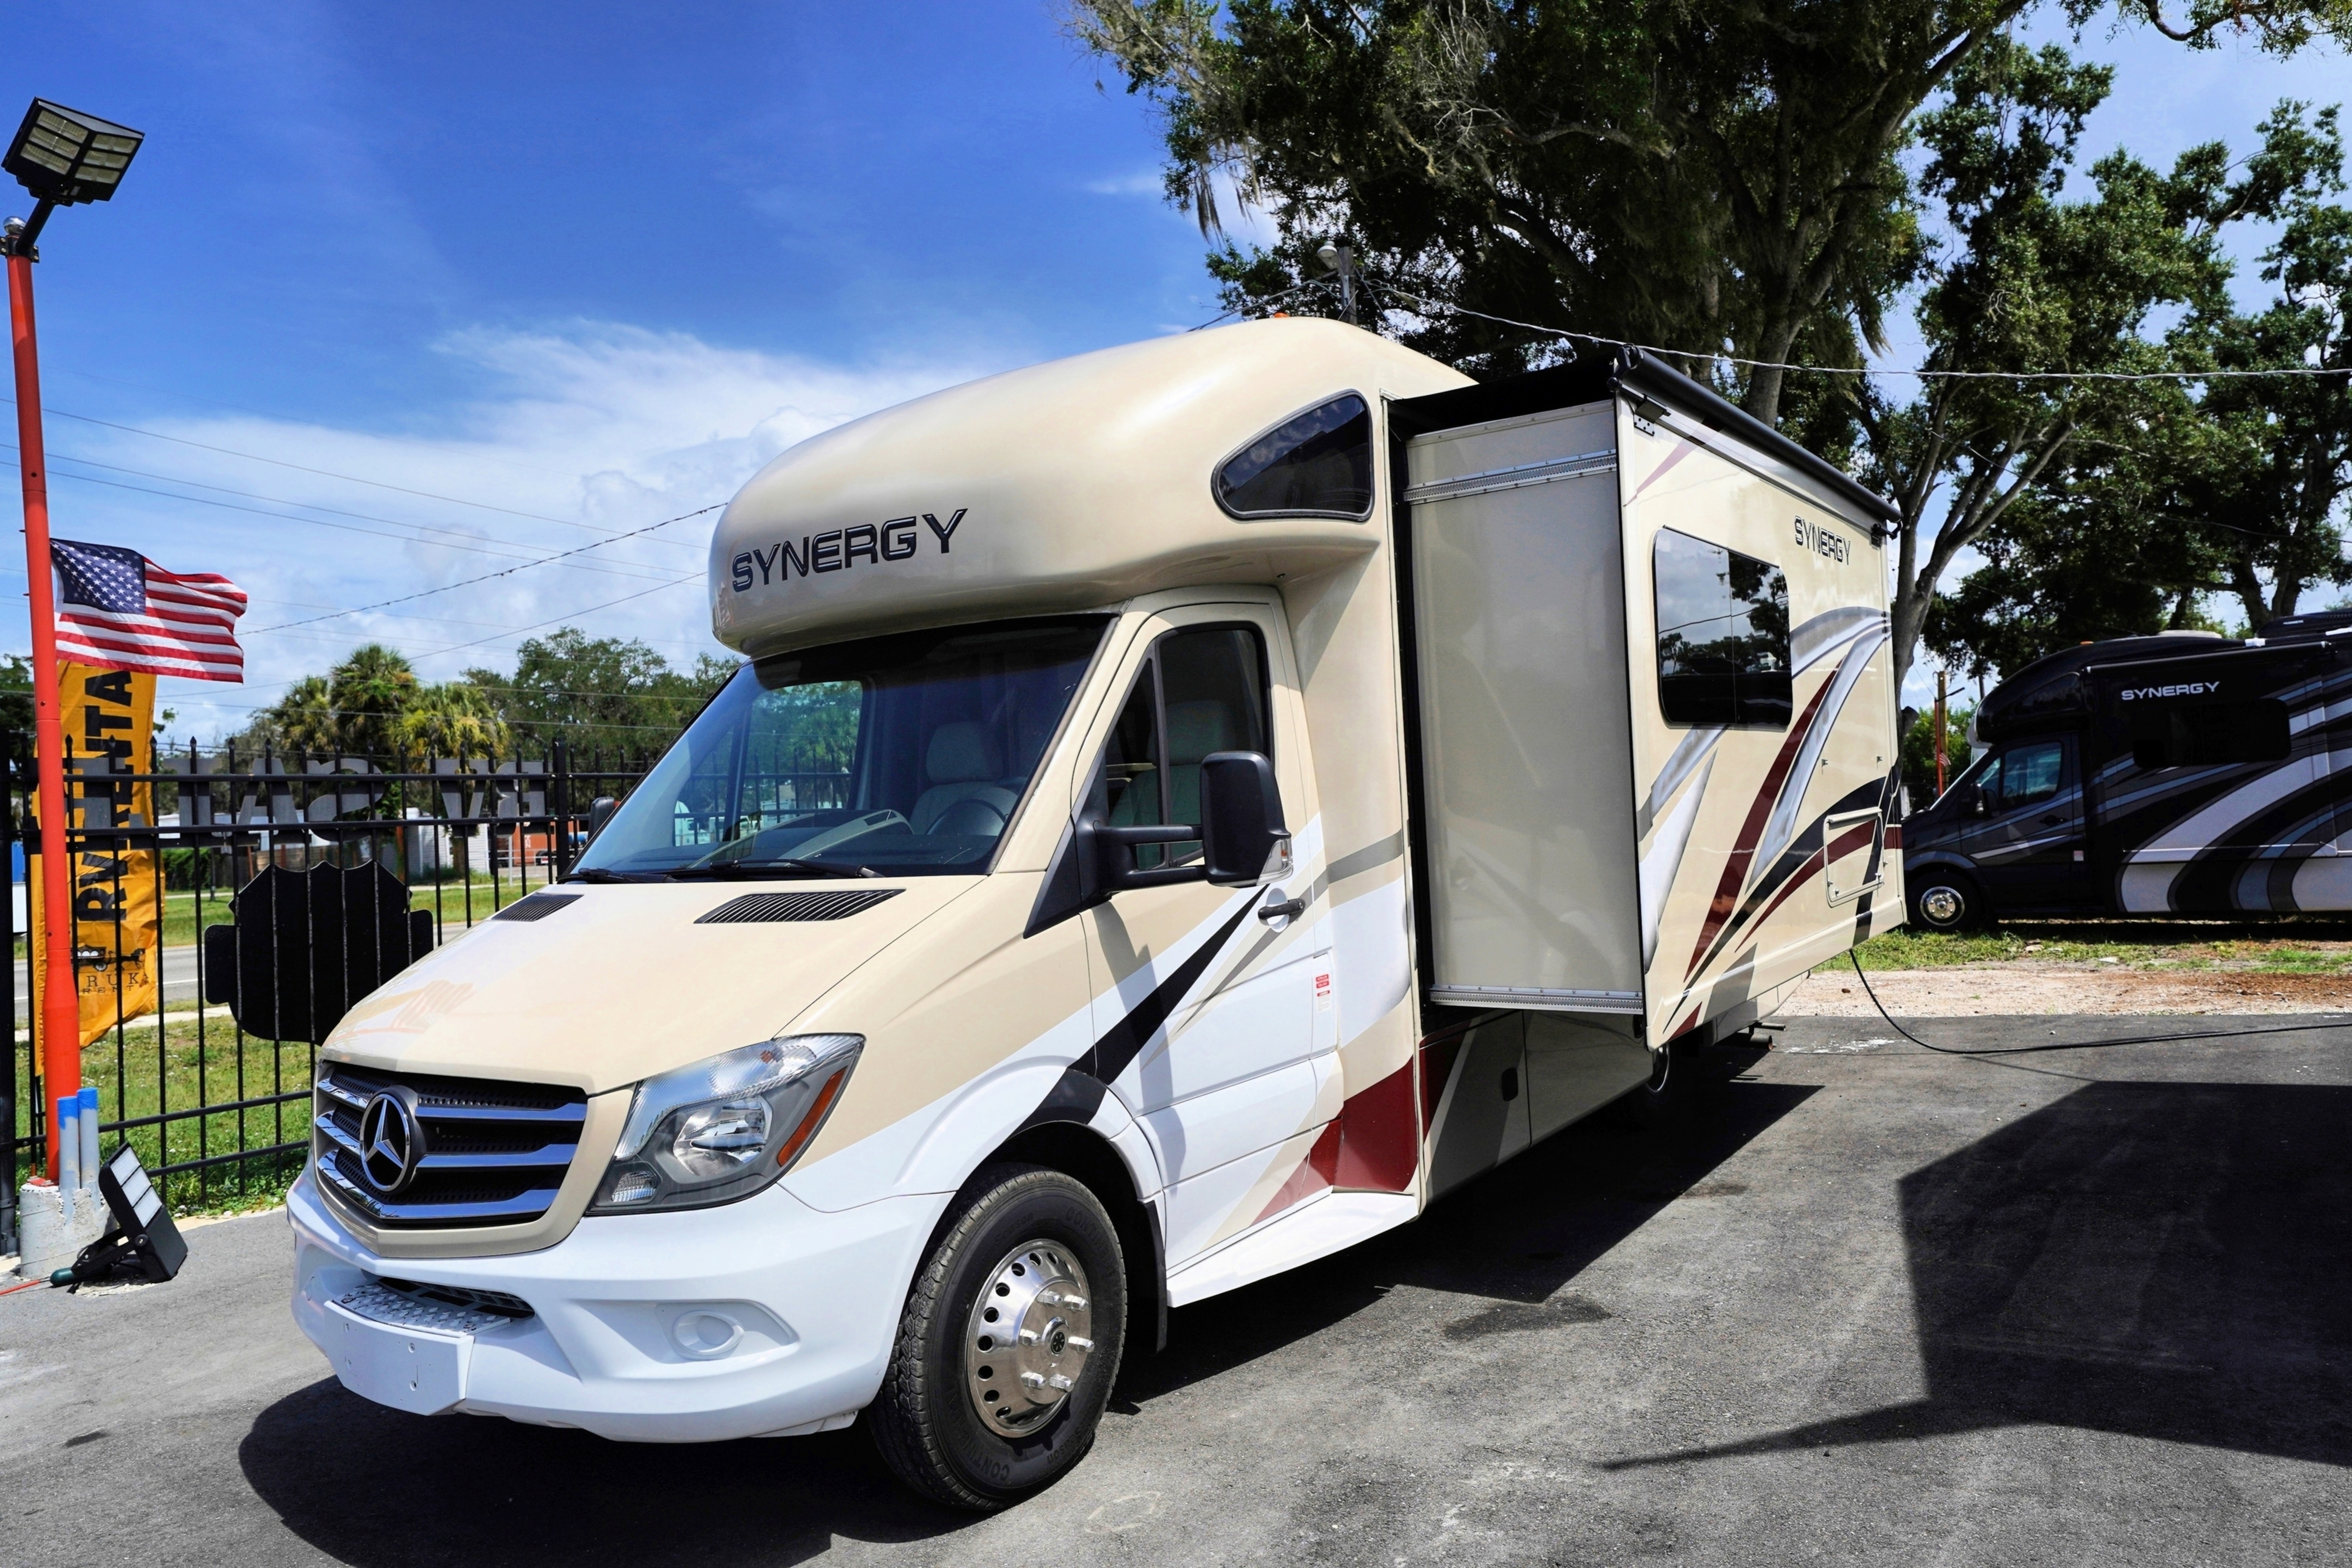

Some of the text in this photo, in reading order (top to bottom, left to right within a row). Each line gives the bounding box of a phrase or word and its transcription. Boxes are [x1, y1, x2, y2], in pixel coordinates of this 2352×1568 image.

[732, 508, 968, 592] SYNERGY
[1795, 515, 1851, 565] SYNERGY
[2121, 681, 2220, 700] SYNERGY
[76, 852, 129, 921] RV
